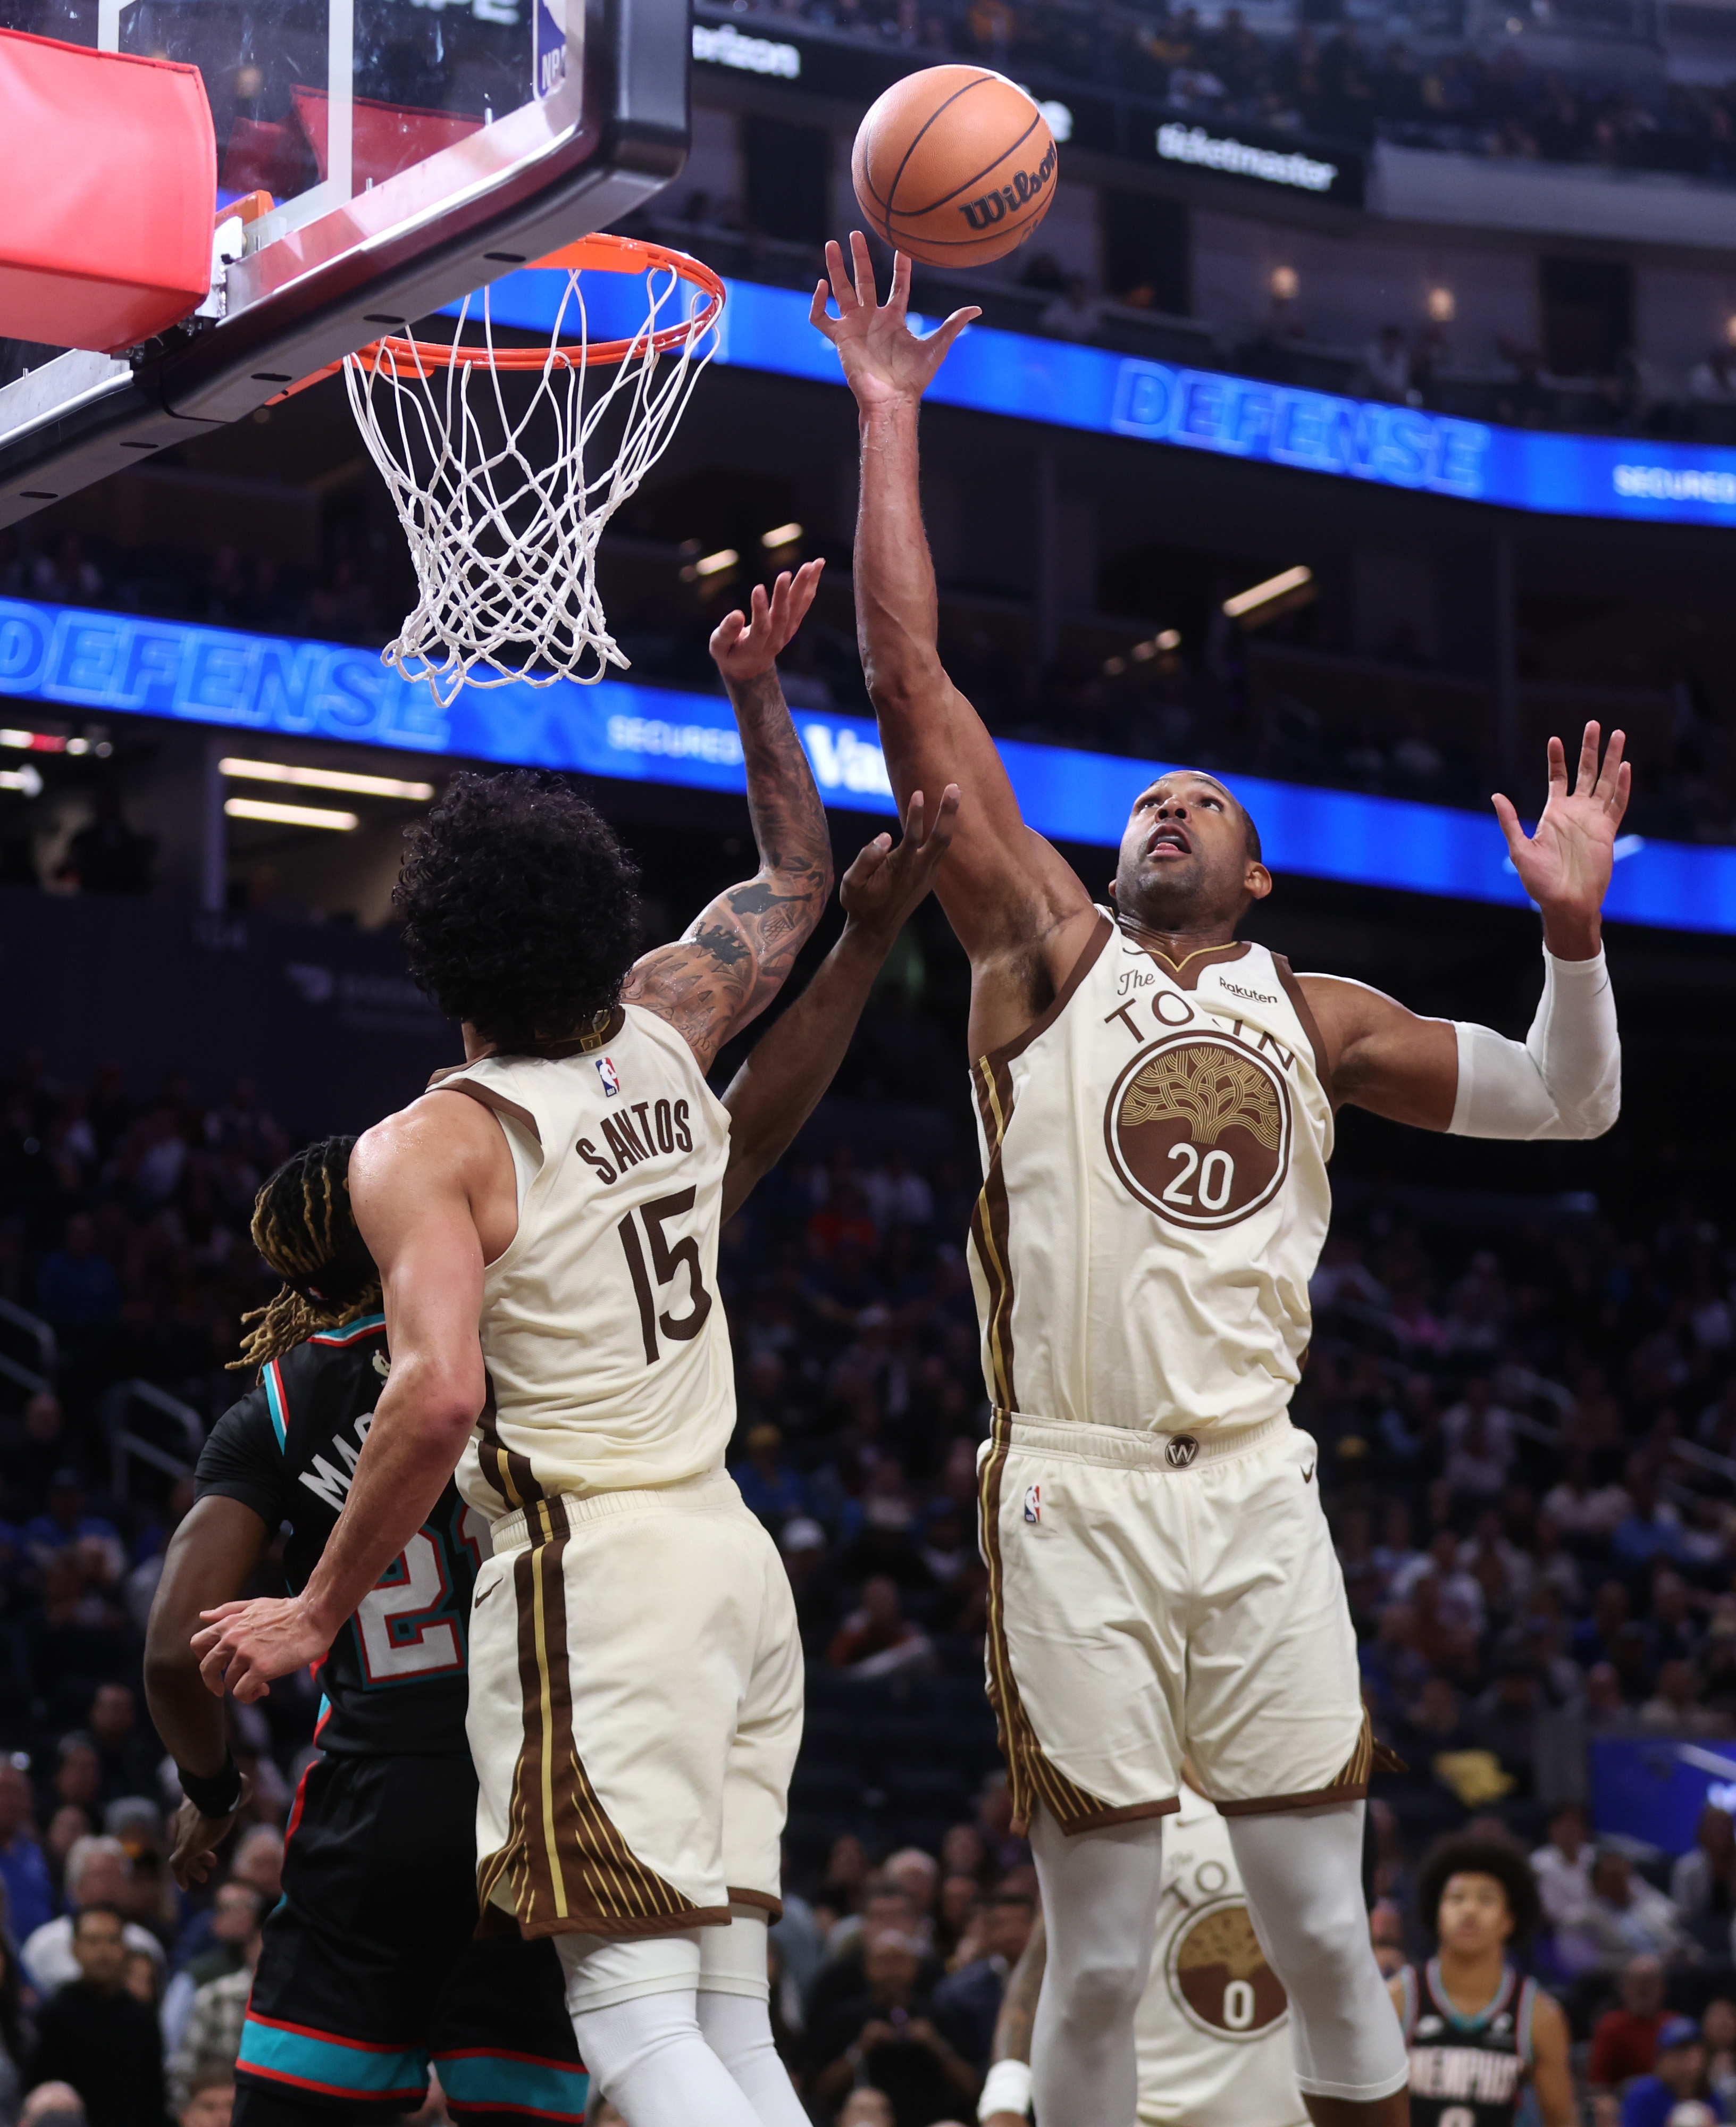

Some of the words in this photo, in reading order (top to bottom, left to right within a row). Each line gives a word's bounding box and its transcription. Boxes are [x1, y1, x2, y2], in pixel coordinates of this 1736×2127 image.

[958, 140, 1058, 231] Wilson
[1110, 357, 1490, 499] DEFENSE
[0, 600, 453, 751] DEFENSE
[1117, 969, 1155, 996] The
[1219, 976, 1278, 1004] Rakuten
[576, 1099, 693, 1185] SANTOS
[1162, 1142, 1235, 1211] 20
[617, 1184, 712, 1366] 15
[1168, 1442, 1197, 1464] W
[1224, 1979, 1255, 2030] 0
